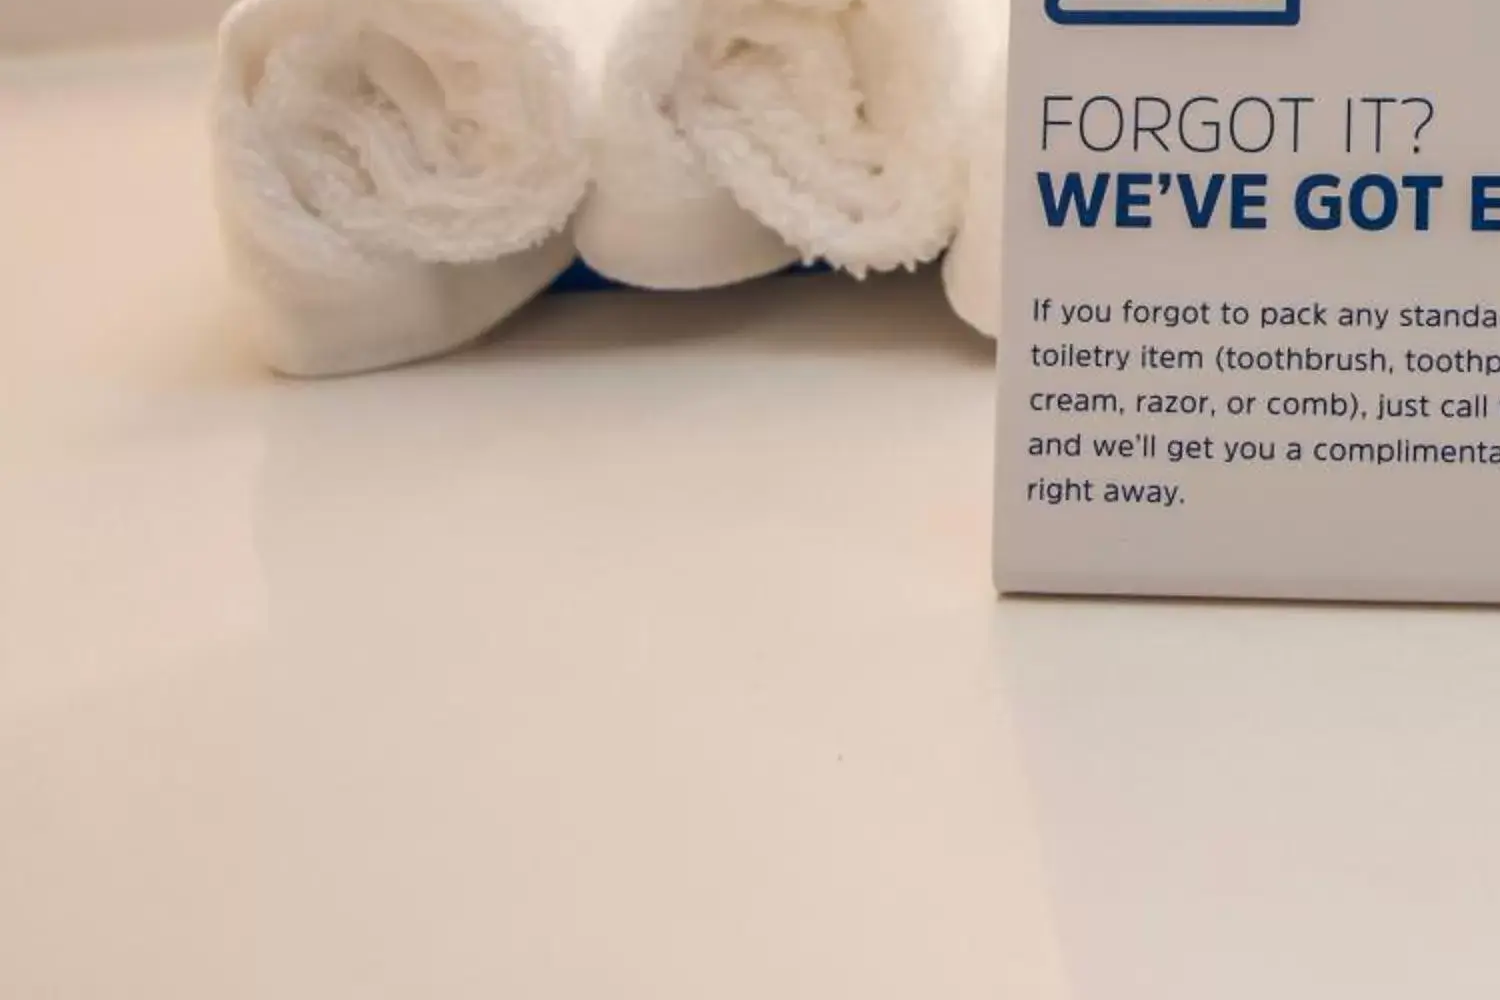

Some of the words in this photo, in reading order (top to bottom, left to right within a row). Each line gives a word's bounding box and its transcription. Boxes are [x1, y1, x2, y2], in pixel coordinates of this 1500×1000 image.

[1042, 95, 1315, 153] FORGOT
[1346, 97, 1434, 154] IT?
[1036, 171, 1268, 230] WE’VE
[1294, 173, 1444, 232] GOT
[1033, 298, 1053, 323] If
[1061, 303, 1111, 325] you
[1122, 299, 1210, 327] forgot
[1220, 302, 1249, 325] to
[1261, 302, 1327, 328] pack
[1338, 307, 1389, 330] any
[1031, 344, 1130, 371] toiletry
[1141, 345, 1202, 369] item
[1216, 346, 1393, 374] (toothbrush,
[1030, 393, 1124, 415] cream,
[1137, 394, 1215, 417] razor,
[1227, 396, 1256, 415] or
[1267, 392, 1366, 420] comb),
[1376, 394, 1430, 420] just
[1441, 395, 1487, 418] call
[1028, 433, 1081, 457] and
[1093, 434, 1155, 457] we'll
[1168, 437, 1214, 462] get
[1224, 441, 1275, 462] you
[1286, 442, 1301, 461] a
[1028, 478, 1093, 505] right
[1104, 483, 1184, 507] away.
